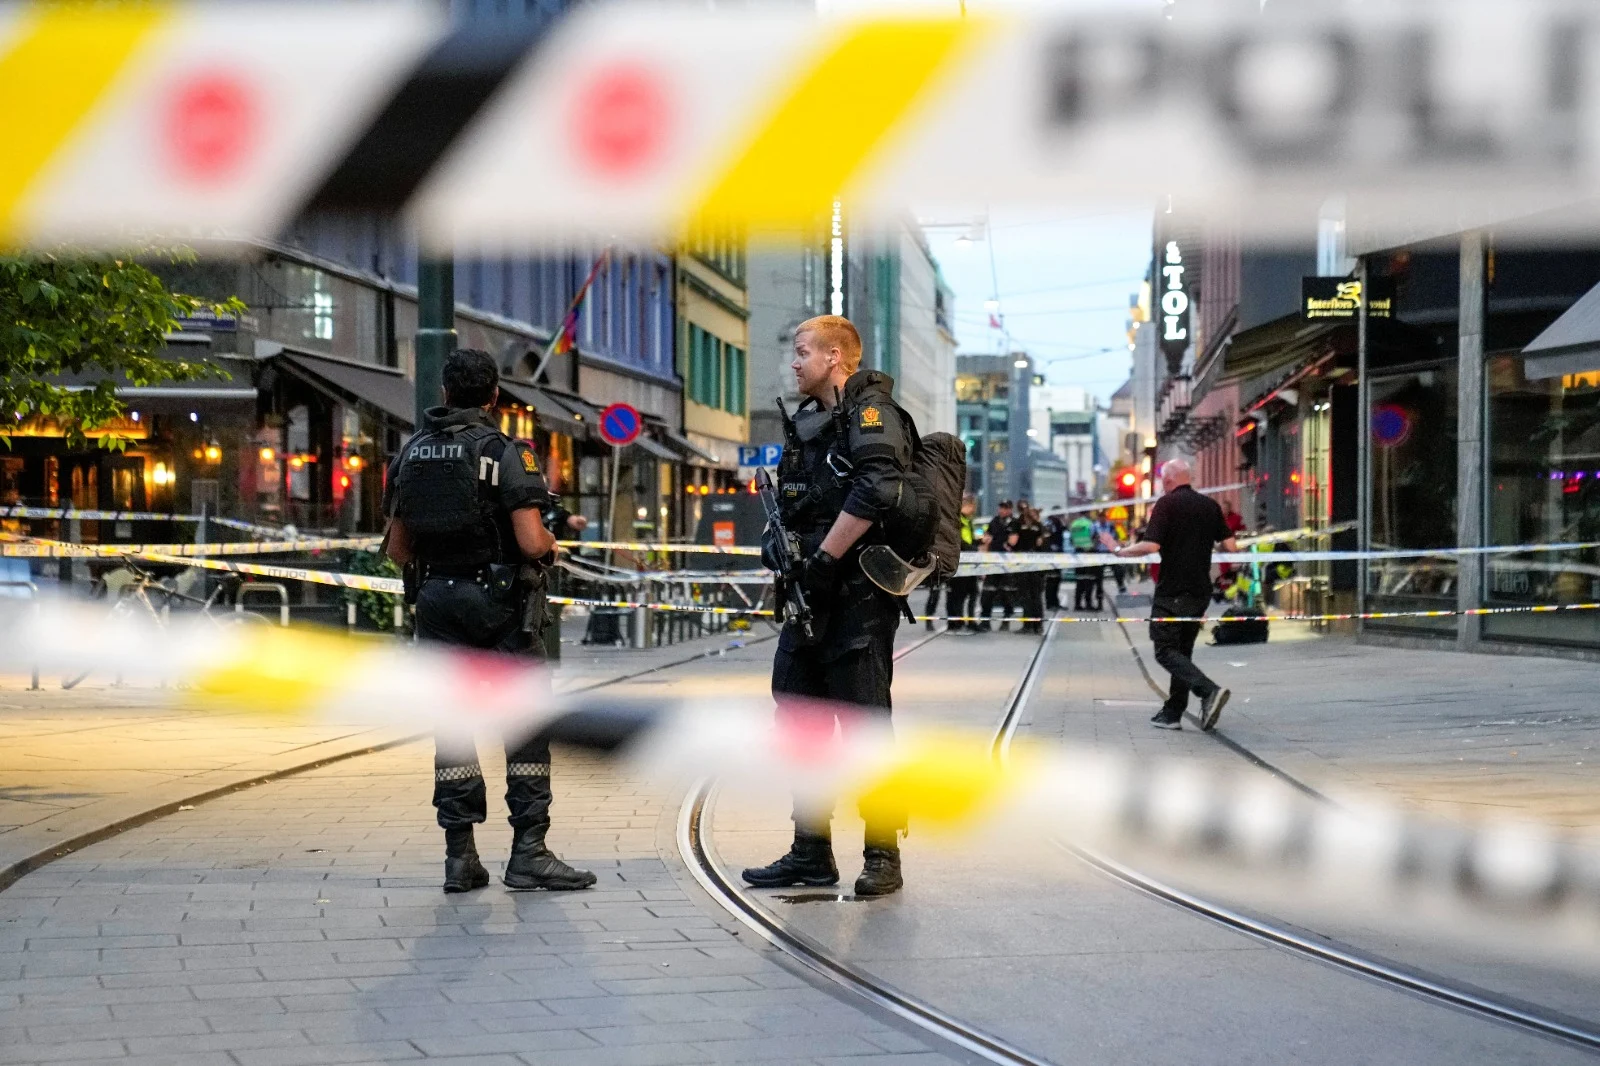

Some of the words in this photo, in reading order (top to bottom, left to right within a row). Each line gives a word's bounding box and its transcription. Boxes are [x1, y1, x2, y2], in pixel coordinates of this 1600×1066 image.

[1307, 297, 1353, 309] Interflora
[409, 444, 463, 460] POLITI
[743, 447, 757, 465] P
[765, 447, 778, 464] P
[783, 483, 806, 491] POLITI
